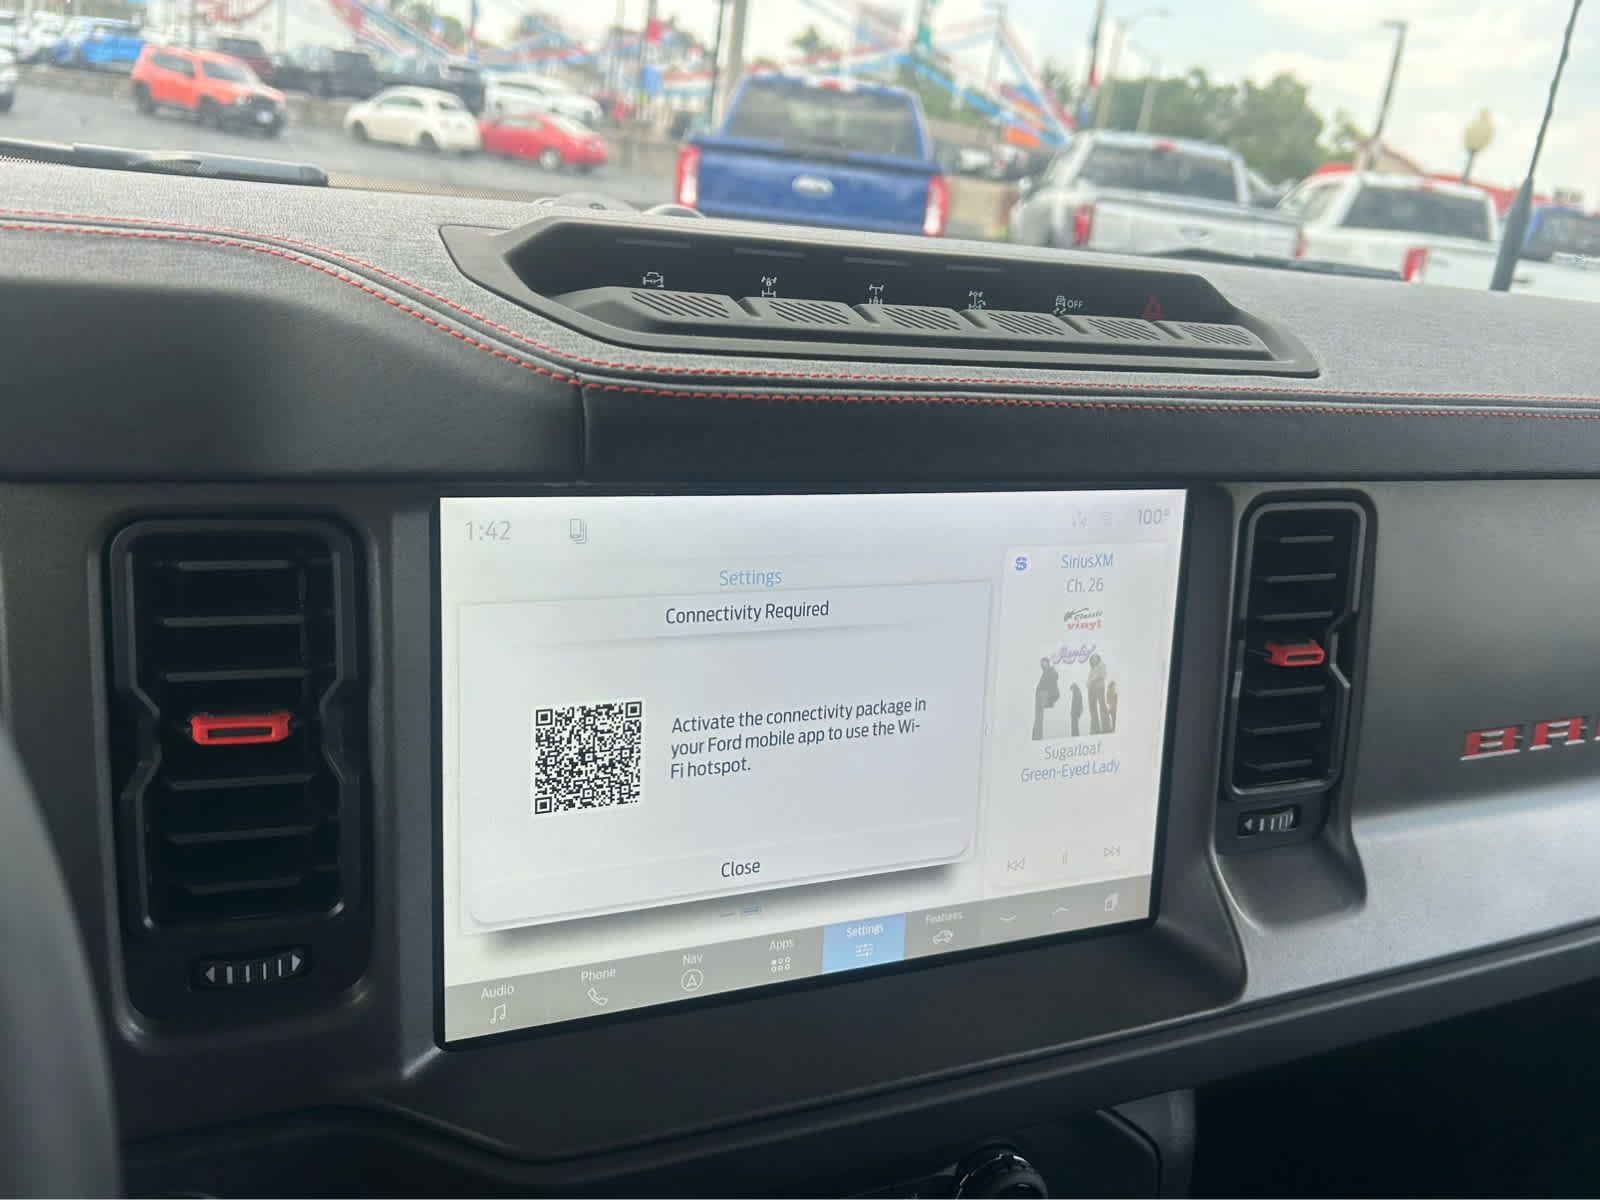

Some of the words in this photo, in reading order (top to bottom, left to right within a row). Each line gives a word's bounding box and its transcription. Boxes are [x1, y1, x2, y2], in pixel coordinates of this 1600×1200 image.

[1066, 300, 1084, 309] OFF
[464, 520, 512, 541] 1:42
[1061, 553, 1114, 569] SiriusXM
[719, 569, 783, 587] Settings
[1066, 578, 1085, 593] Ch.
[1088, 577, 1104, 592] 26
[666, 605, 762, 624] Connectivity
[765, 600, 829, 620] Required
[672, 714, 735, 733] Activate
[739, 712, 763, 727] the
[766, 704, 852, 725] connectivity
[856, 699, 912, 719] package
[914, 697, 926, 712] in
[671, 740, 704, 759] your
[708, 734, 742, 752] Ford
[745, 730, 795, 749] mobile
[798, 729, 825, 745] app
[828, 727, 842, 741] to
[846, 725, 869, 739] use
[873, 721, 895, 737] the
[898, 719, 920, 734] Wi-
[1043, 741, 1102, 760] Sugarloaf
[671, 763, 684, 779] Fi
[688, 757, 751, 777] hotspot.
[1020, 760, 1090, 783] Green-Eyed
[1092, 759, 1120, 774] Lady
[721, 860, 761, 878] Close
[925, 911, 963, 925] Features
[846, 922, 884, 938] Settings
[769, 938, 794, 952] Apps
[682, 954, 703, 966] Nav
[581, 968, 617, 983] Phone
[481, 984, 514, 1000] Audio
